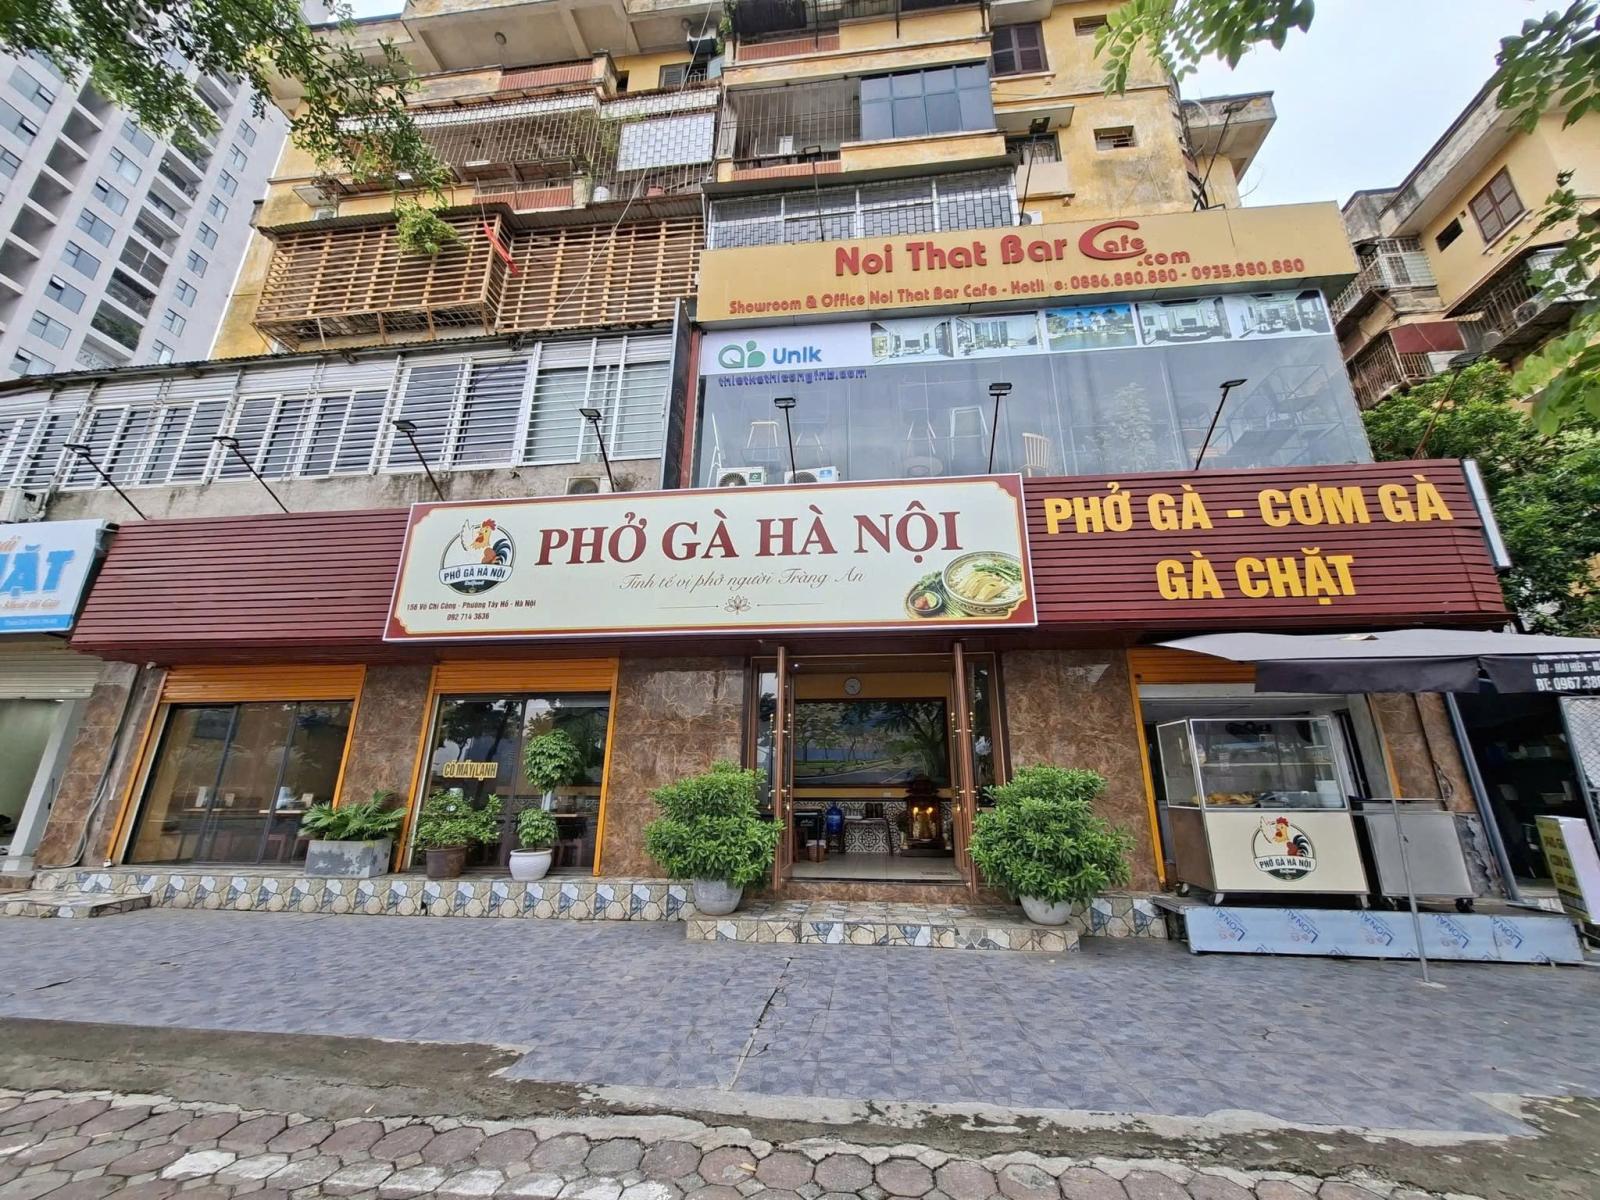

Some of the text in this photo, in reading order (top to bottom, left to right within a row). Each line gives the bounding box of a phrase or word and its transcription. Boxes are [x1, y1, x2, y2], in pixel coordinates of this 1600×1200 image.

[835, 220, 1147, 276] Noi That Bar Cafe
[729, 299, 802, 314] Showroom
[806, 295, 817, 308] &
[822, 293, 865, 308] Office
[897, 287, 930, 302] That
[933, 286, 959, 300] Bar
[963, 283, 997, 298] Cafe
[1070, 268, 1178, 290] 0886.880.880
[1191, 258, 1305, 280] 0935.880.880
[534, 500, 964, 566] PHỞ GÀ HÀ NỘI
[1043, 474, 1455, 535] PHỞ GÀ - CƠM GÀ
[444, 568, 461, 581] PHỞ
[490, 566, 506, 580] NỘI
[1155, 546, 1357, 605] GÀ CHẶT
